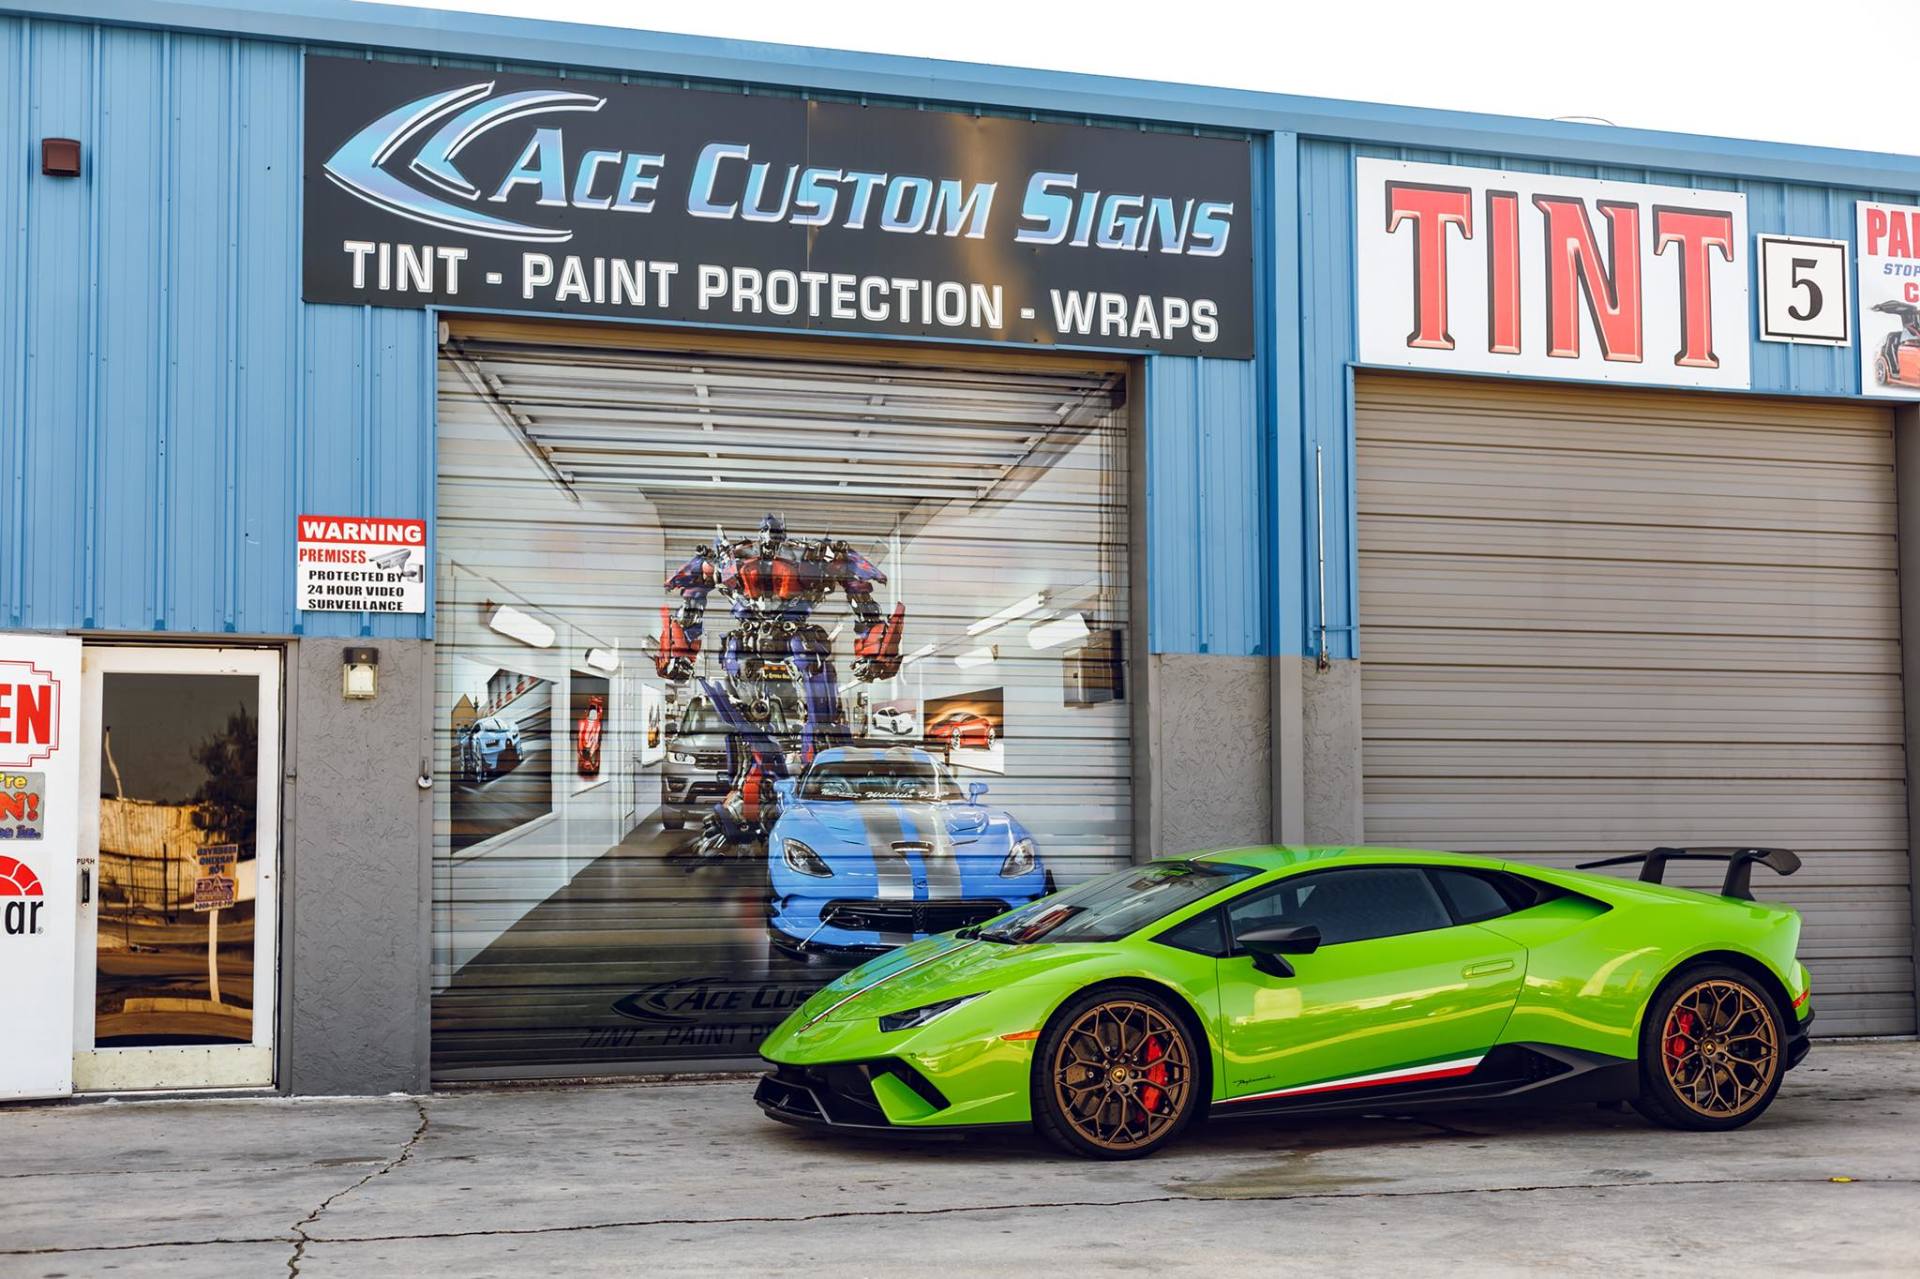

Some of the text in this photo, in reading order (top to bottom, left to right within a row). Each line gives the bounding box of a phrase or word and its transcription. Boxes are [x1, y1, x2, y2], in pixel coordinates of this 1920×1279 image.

[1384, 180, 1734, 369] TINT
[343, 240, 469, 295] TINT
[522, 252, 679, 308] PAINT
[698, 264, 1004, 330] PROTECTION
[1050, 288, 1220, 344] WRAPS
[1786, 257, 1825, 322] 5
[302, 521, 422, 543] WARNING
[299, 548, 367, 564] PREMISES
[308, 570, 404, 583] PROTECTED BY
[307, 584, 405, 598] 24 HOUR VIDEO
[308, 598, 405, 612] SURVEILLANCE
[580, 1028, 643, 1048] TINT
[662, 1024, 736, 1046] PAINT
